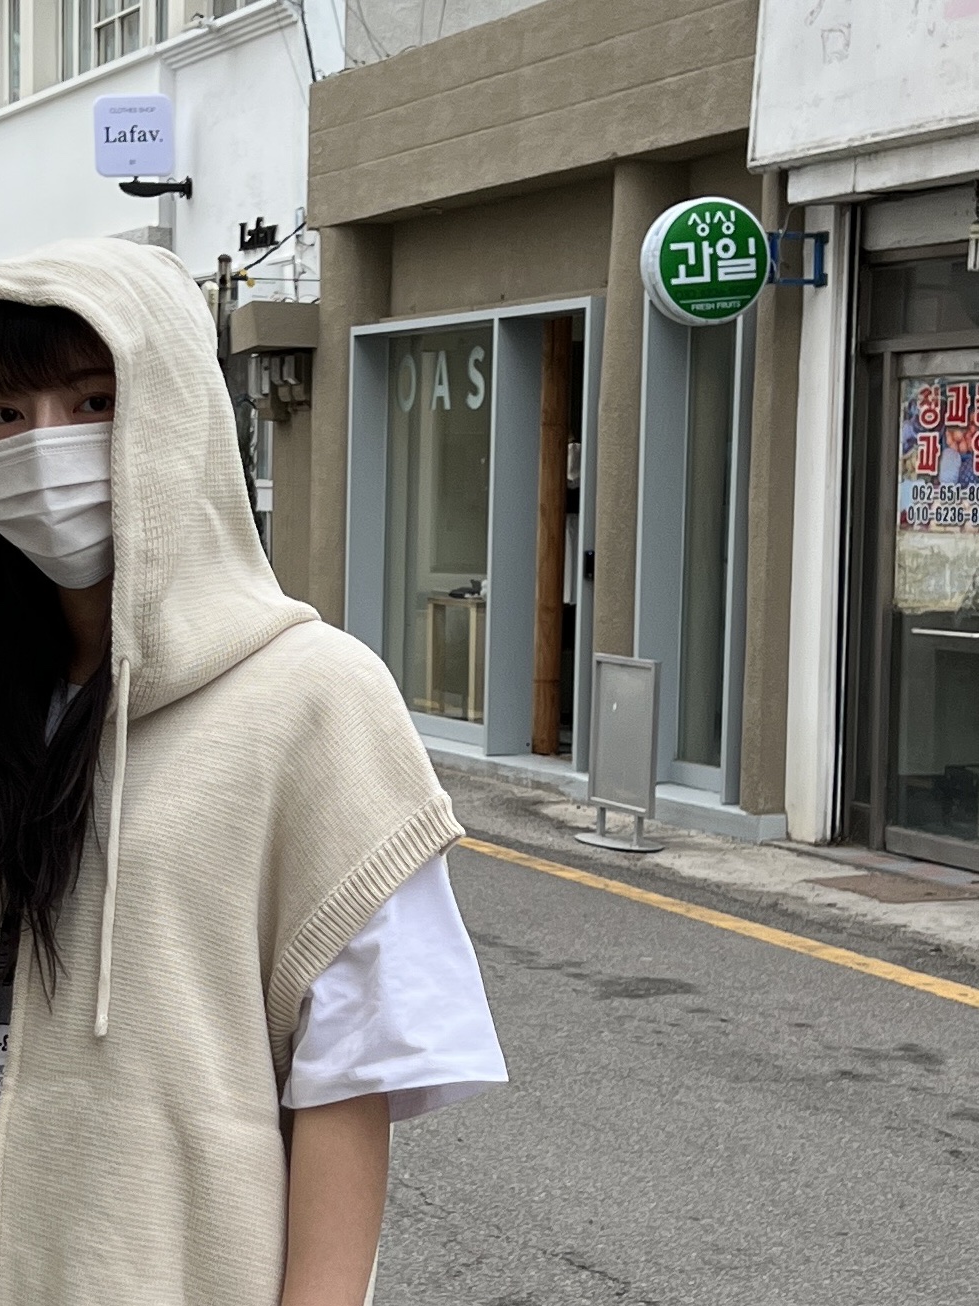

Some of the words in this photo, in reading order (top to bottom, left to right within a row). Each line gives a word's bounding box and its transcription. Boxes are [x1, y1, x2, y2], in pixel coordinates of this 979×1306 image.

[104, 125, 163, 143] Lafav.
[687, 209, 736, 237] 싱싱
[669, 237, 757, 285] 과일
[919, 385, 979, 427] 청과
